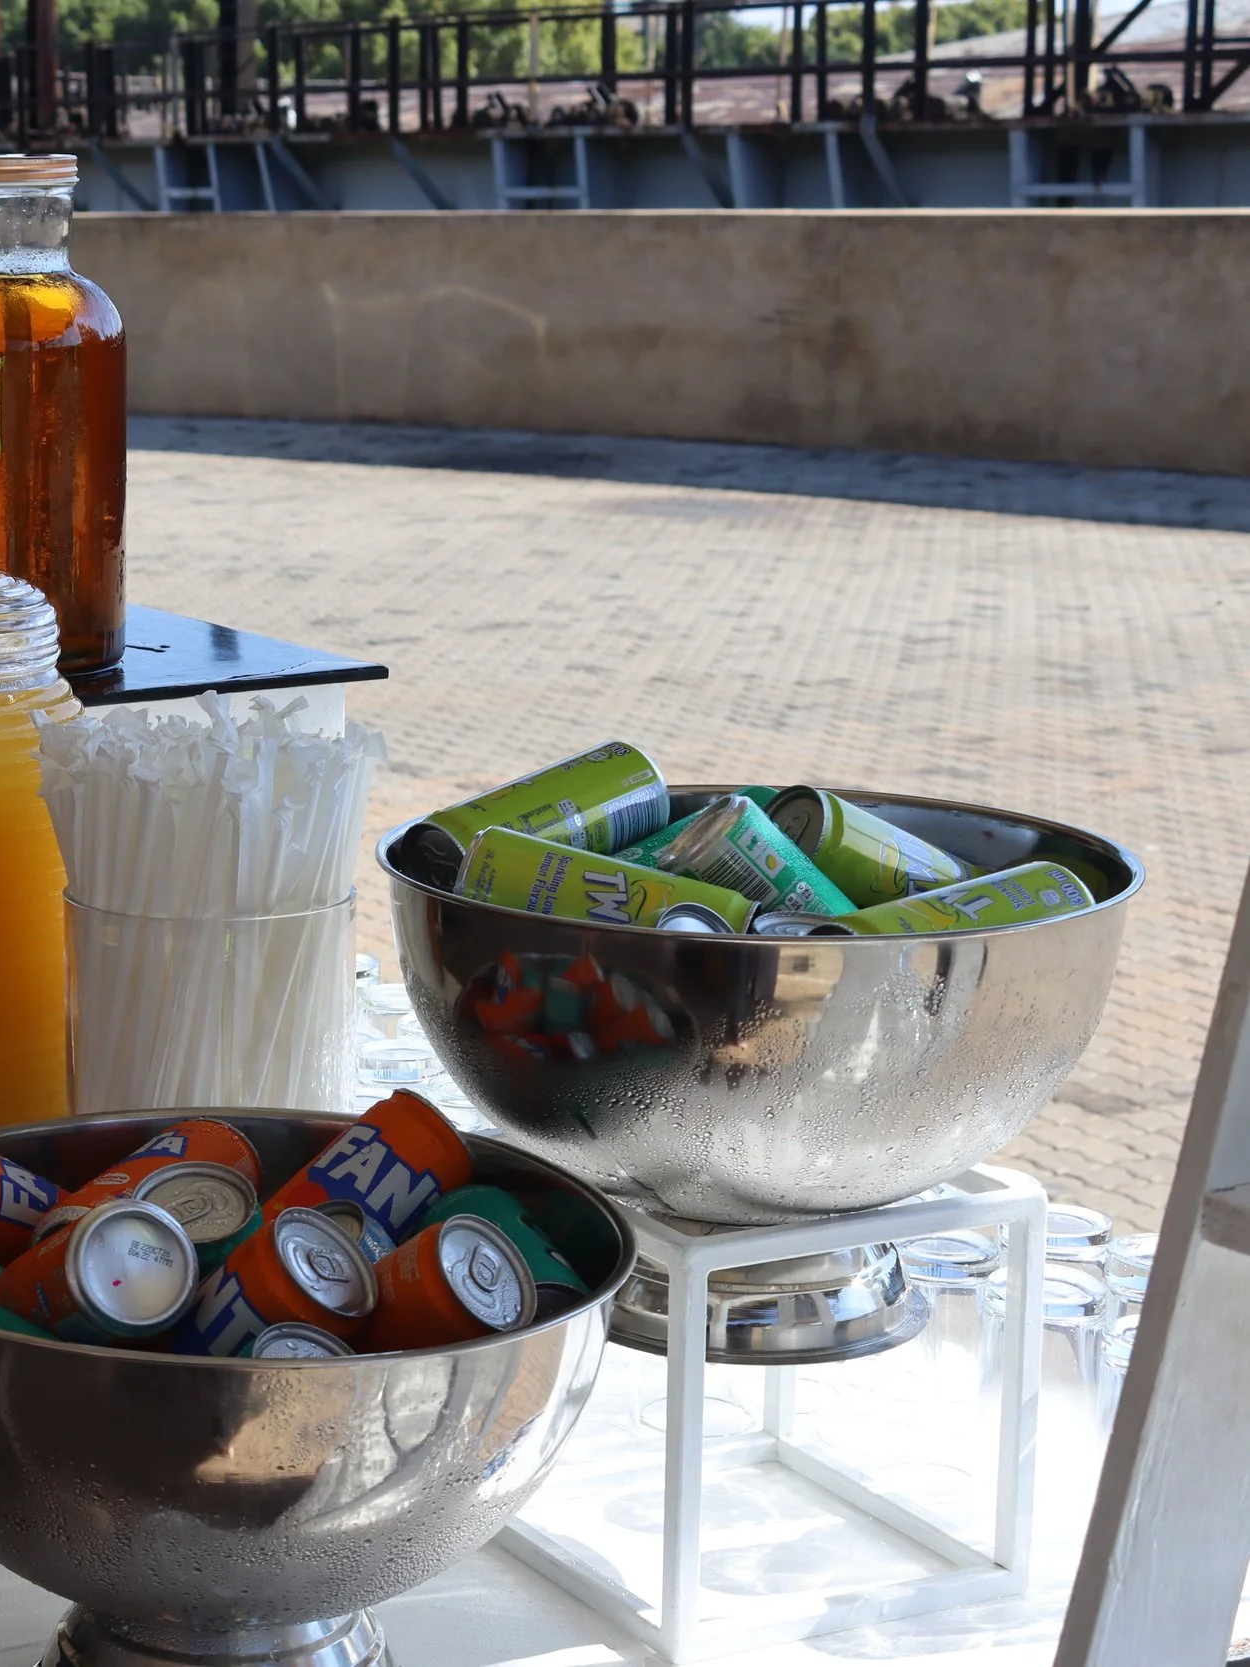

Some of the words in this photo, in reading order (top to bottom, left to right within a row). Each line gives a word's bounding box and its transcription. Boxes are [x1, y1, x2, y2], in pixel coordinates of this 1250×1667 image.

[540, 851, 558, 876] Lemon
[547, 855, 574, 892] Sparkling
[314, 1123, 440, 1230] FAN
